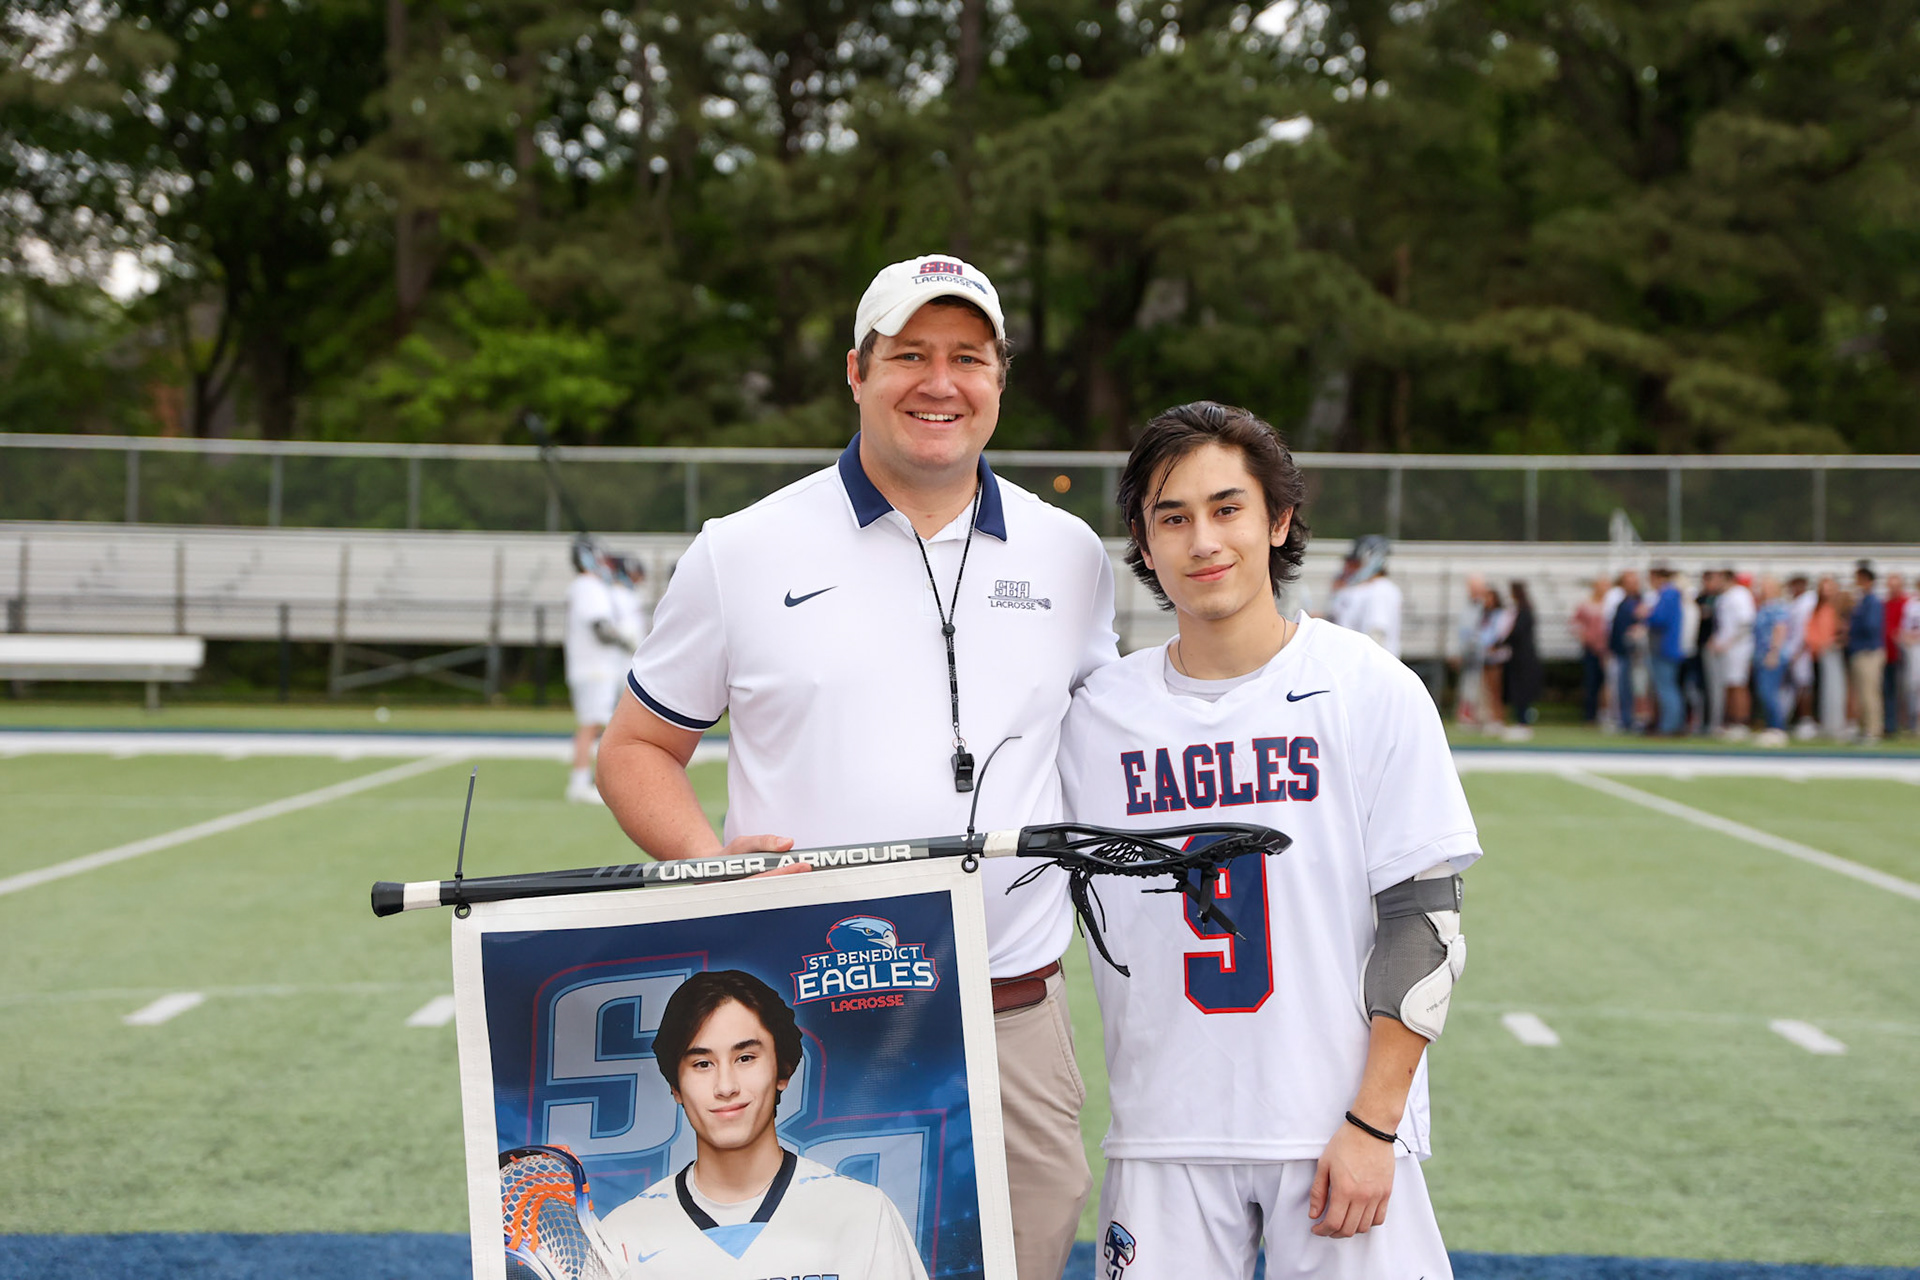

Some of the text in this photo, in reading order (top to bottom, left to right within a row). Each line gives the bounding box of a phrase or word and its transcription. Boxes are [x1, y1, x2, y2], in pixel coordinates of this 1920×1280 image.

[919, 261, 963, 276] SBA
[914, 275, 972, 288] LACROSSE
[995, 579, 1030, 598] SBA
[990, 600, 1036, 610] LACROSSE
[1120, 736, 1320, 815] EAGLES
[659, 844, 912, 881] UNDER ARMOUR
[1181, 831, 1275, 1015] 9
[809, 946, 920, 970] ST. BENEDICT
[798, 961, 935, 999] EAGLES
[830, 994, 905, 1013] LACROSSE
